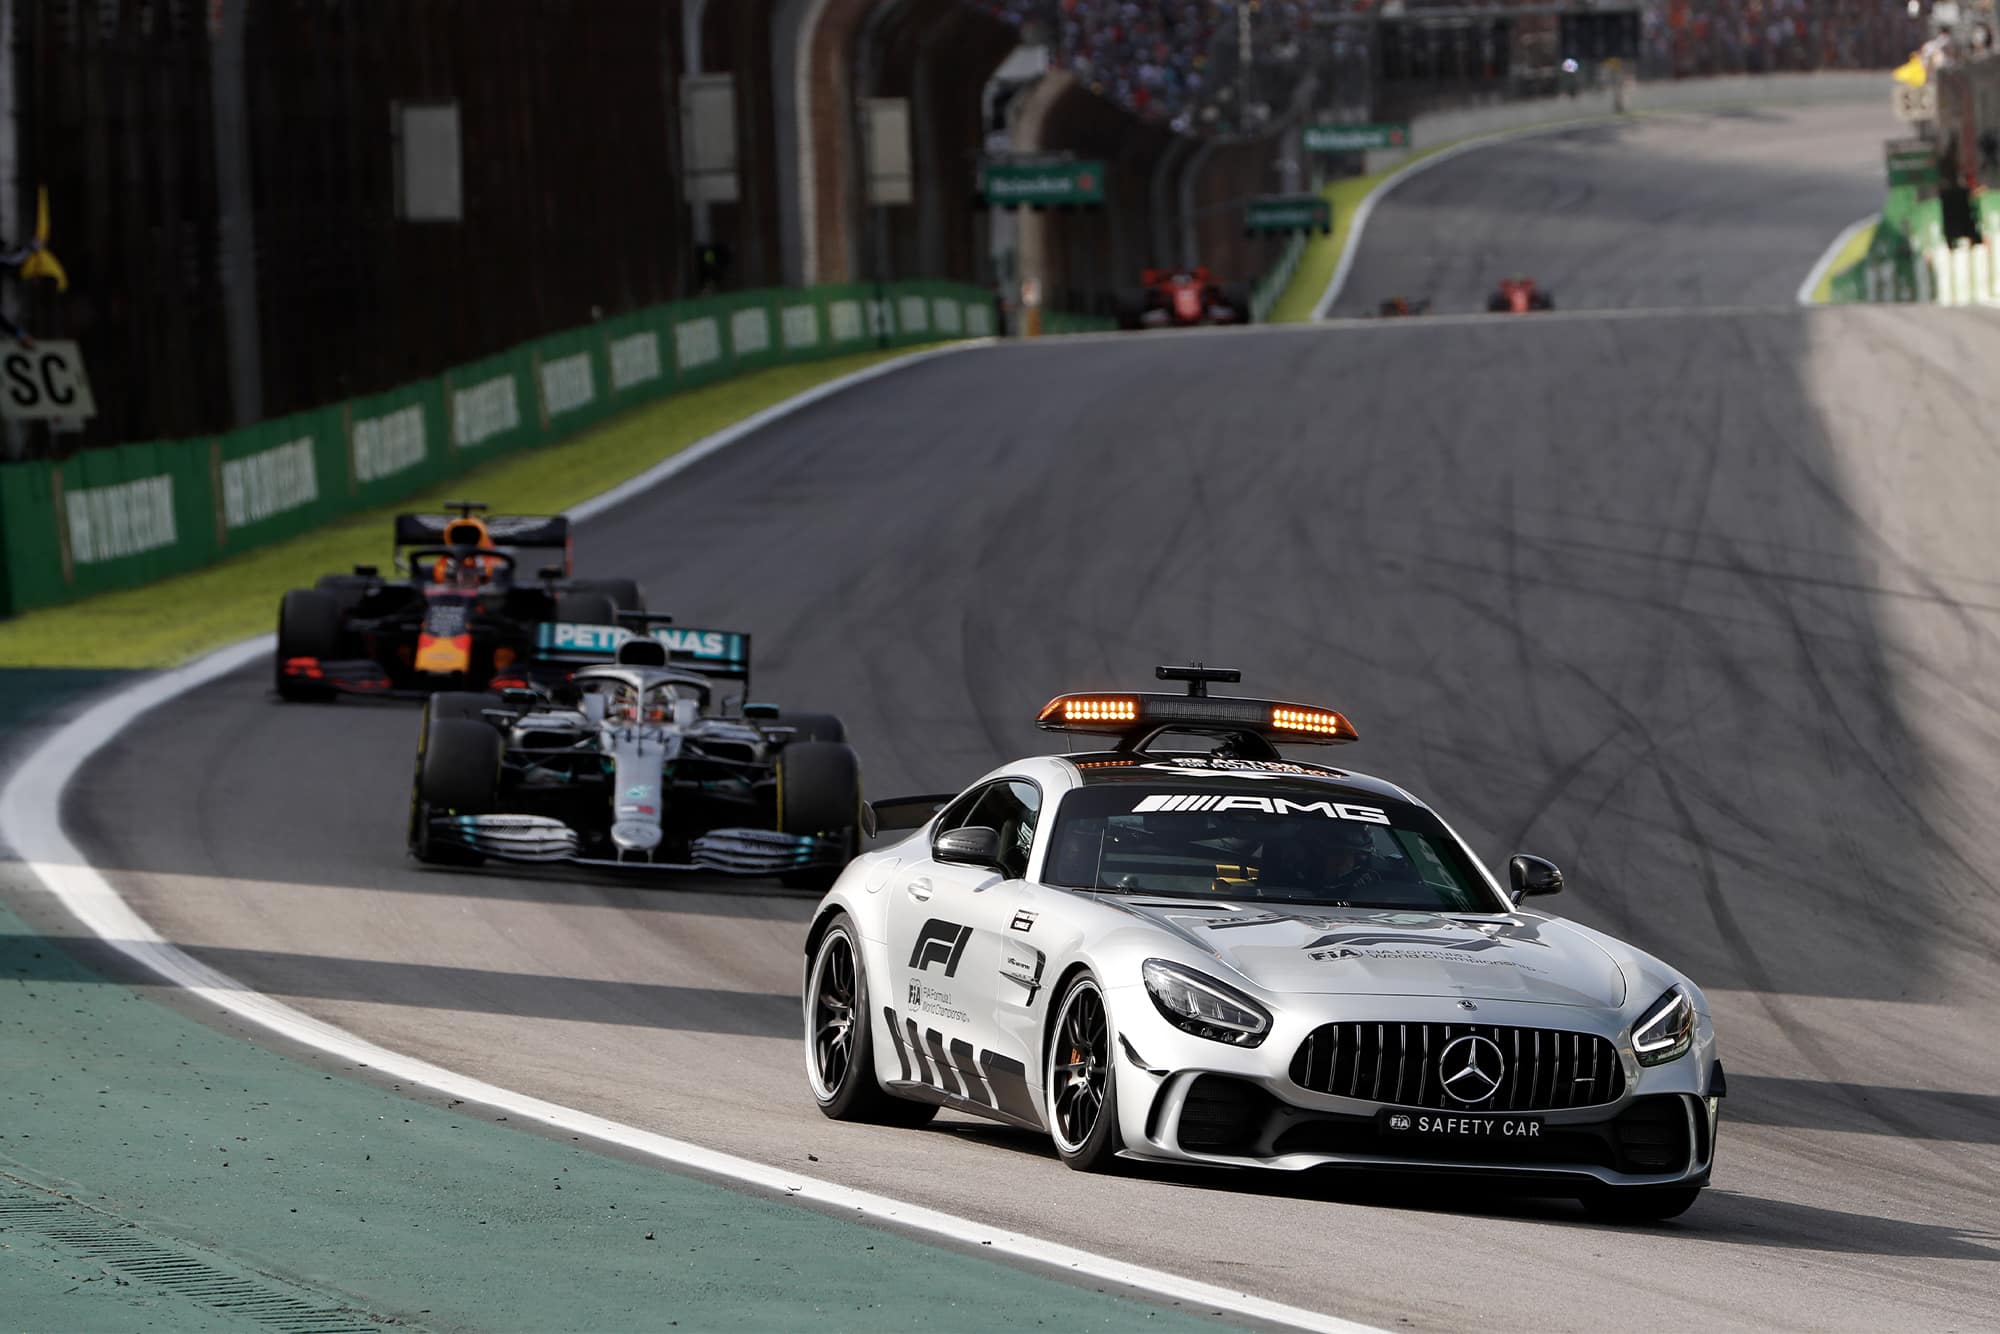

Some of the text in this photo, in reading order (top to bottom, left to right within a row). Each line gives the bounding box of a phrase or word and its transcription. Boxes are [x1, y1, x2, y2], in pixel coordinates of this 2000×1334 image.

[6, 353, 73, 406] SC
[554, 624, 724, 654] PETRNAS
[1213, 795, 1391, 825] AMG
[908, 918, 974, 978] F1
[1310, 949, 1360, 962] FIA
[908, 984, 921, 1005] FIA
[1390, 1116, 1540, 1137] FIA SAFETY CAR
